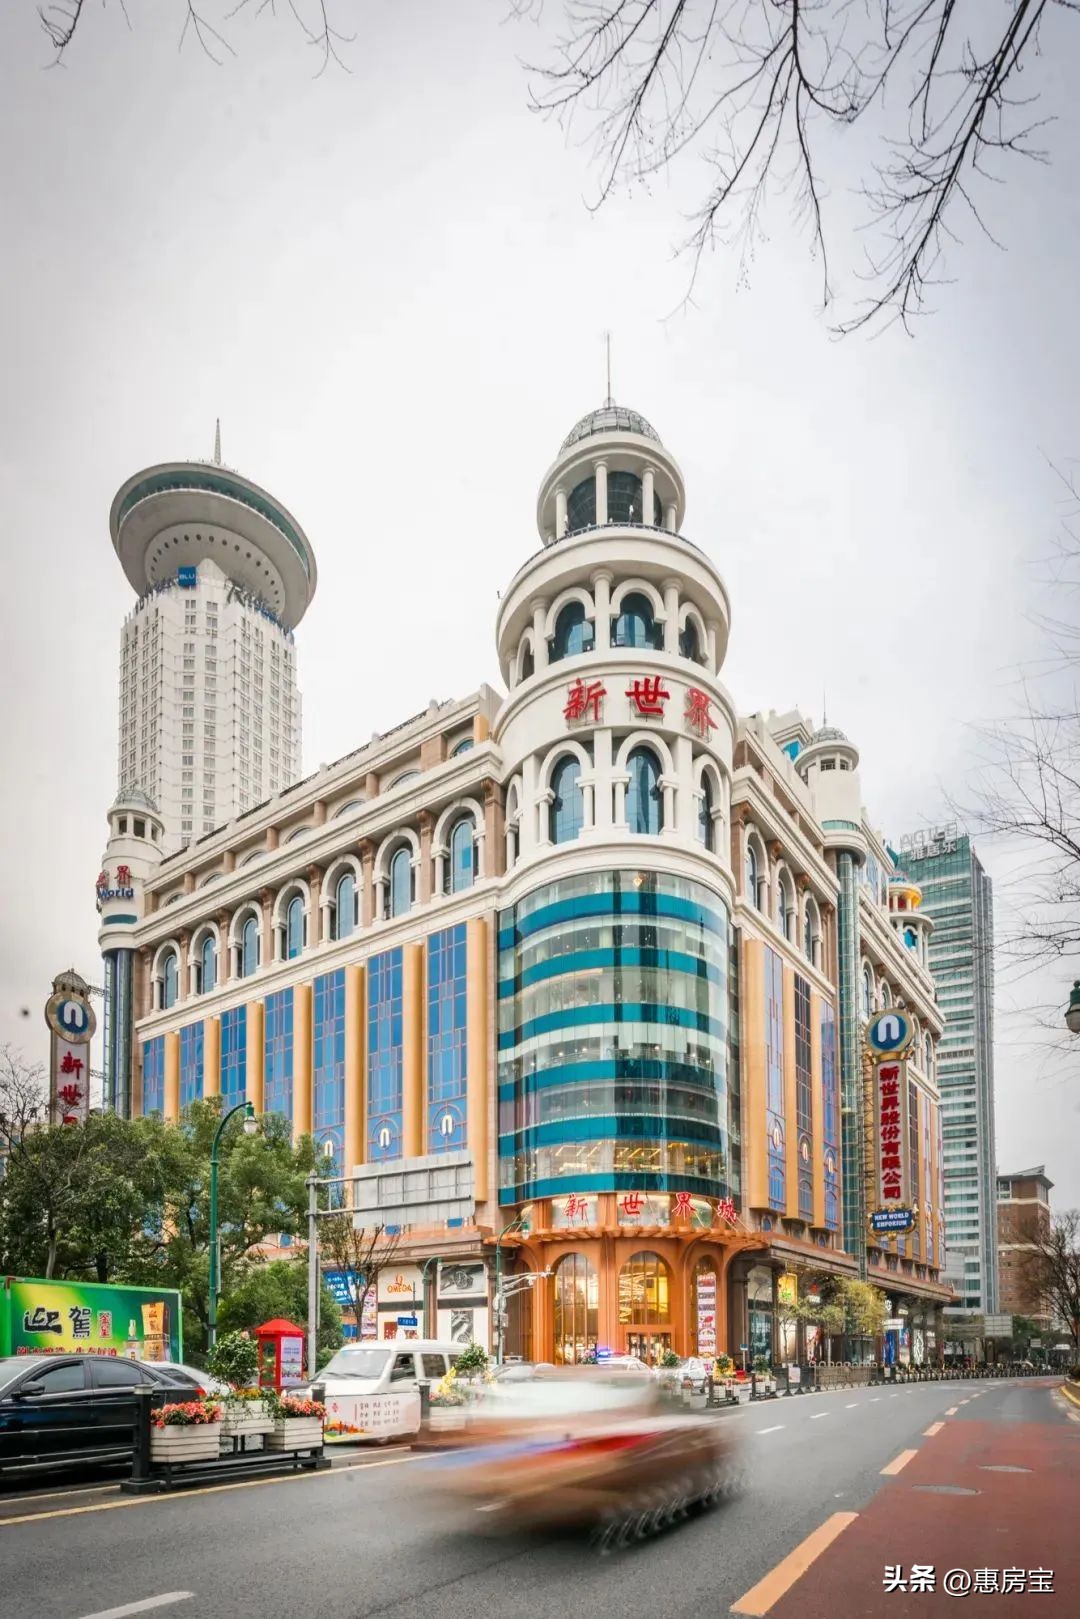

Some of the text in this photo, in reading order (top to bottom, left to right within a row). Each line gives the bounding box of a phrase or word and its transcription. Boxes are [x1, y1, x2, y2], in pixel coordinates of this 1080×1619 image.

[562, 675, 718, 736] 新世界
[911, 841, 957, 861] 雅居乐
[879, 1065, 902, 1200] 新世界股份有限公司
[564, 1192, 737, 1223] 新世界城
[888, 1212, 909, 1220] WORLD
[876, 1220, 907, 1228] EMPORIUM
[387, 1284, 412, 1294] OMEGA
